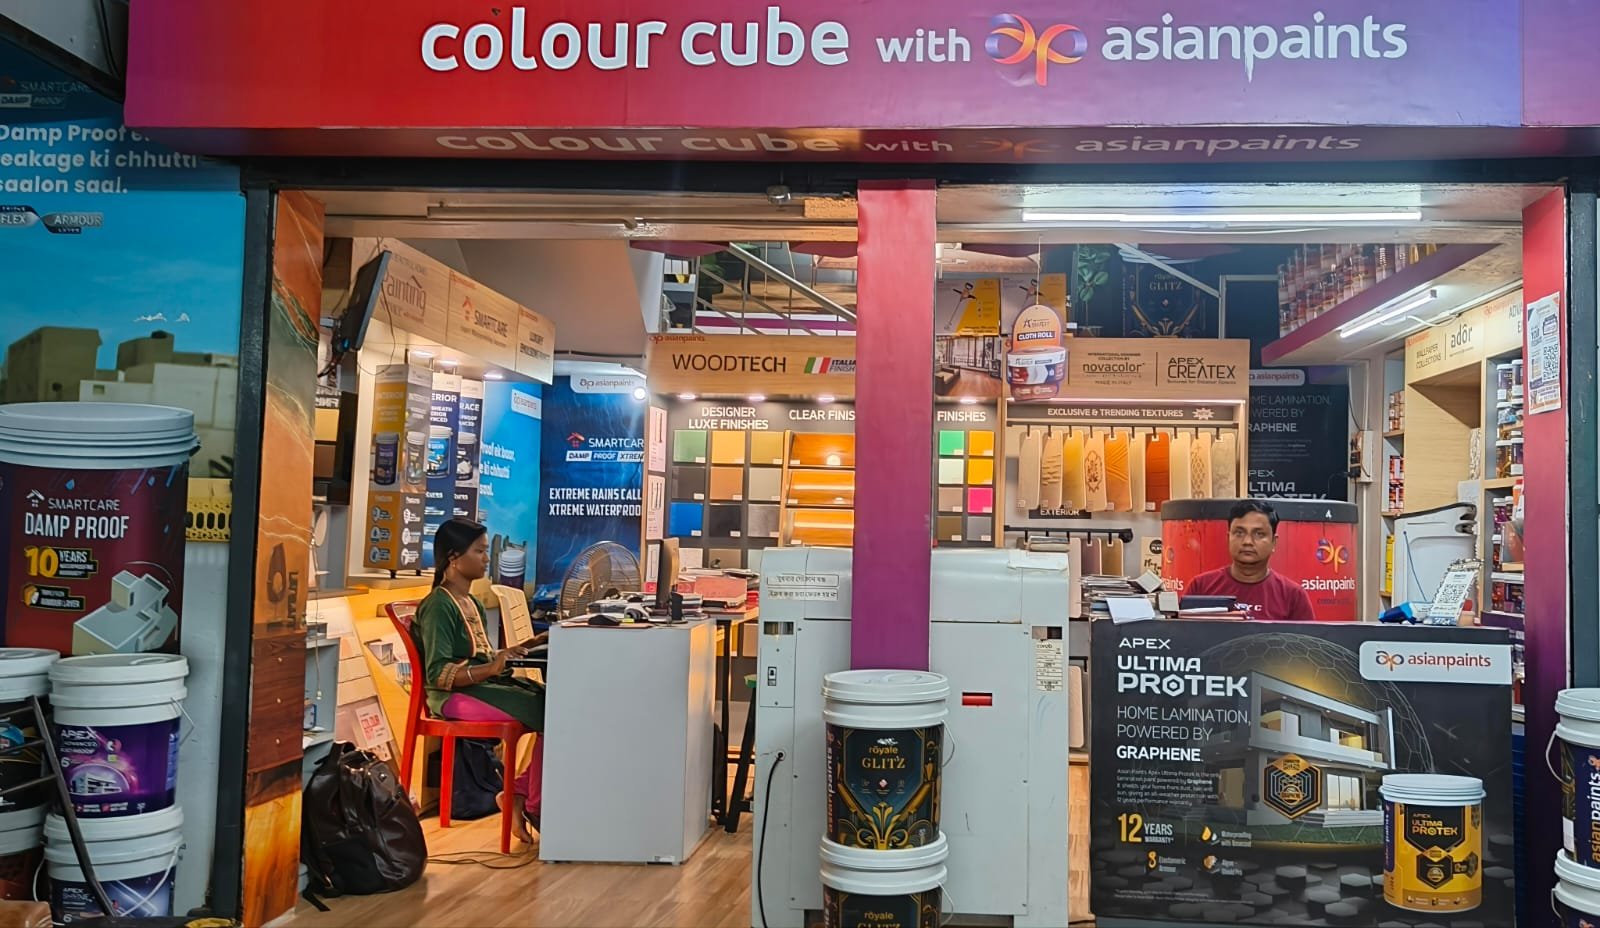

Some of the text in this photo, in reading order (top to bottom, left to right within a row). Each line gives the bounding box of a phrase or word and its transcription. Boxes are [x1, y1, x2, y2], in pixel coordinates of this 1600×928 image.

[421, 6, 1408, 84] colour cube with asianpaints
[68, 125, 125, 142] Proof
[436, 132, 1361, 158] colour cube with asianpaints
[90, 149, 110, 167] ki
[74, 175, 128, 193] saal.
[54, 215, 102, 226] ARMOUR
[384, 274, 427, 317] ainting
[672, 354, 787, 373] WOODTECH
[1082, 362, 1142, 373] novacolor
[1168, 357, 1205, 365] APEX
[1256, 372, 1300, 382] asianpaints
[702, 407, 756, 418] DESIGNER
[789, 410, 826, 421] CLEAR
[937, 411, 987, 422] FINISHES
[1047, 408, 1184, 417] EXCLUSIVE & TRENDING TEXTURES
[689, 419, 769, 430] LUXE FINISHES
[549, 488, 590, 500] EXTREME
[592, 488, 619, 500] RAINS
[48, 498, 121, 511] SMARTCARE
[549, 504, 585, 516] XTREME
[1040, 508, 1080, 516] EXTERIOR
[25, 512, 130, 539] DAMP PROOF
[24, 546, 88, 577] 10 YEARS
[1302, 575, 1356, 596] asianpaints
[1118, 638, 1171, 650] APEX
[1117, 655, 1201, 673] ULTIMA
[1407, 651, 1491, 672] asianpaints
[1117, 672, 1248, 698] PROTEK
[1117, 705, 1251, 726] HOME LAMINATION,
[1117, 724, 1214, 741] POWERED BY
[861, 757, 906, 769] GLITZ
[1118, 812, 1173, 843] 12 YEARS
[1412, 826, 1458, 836] PROTEK
